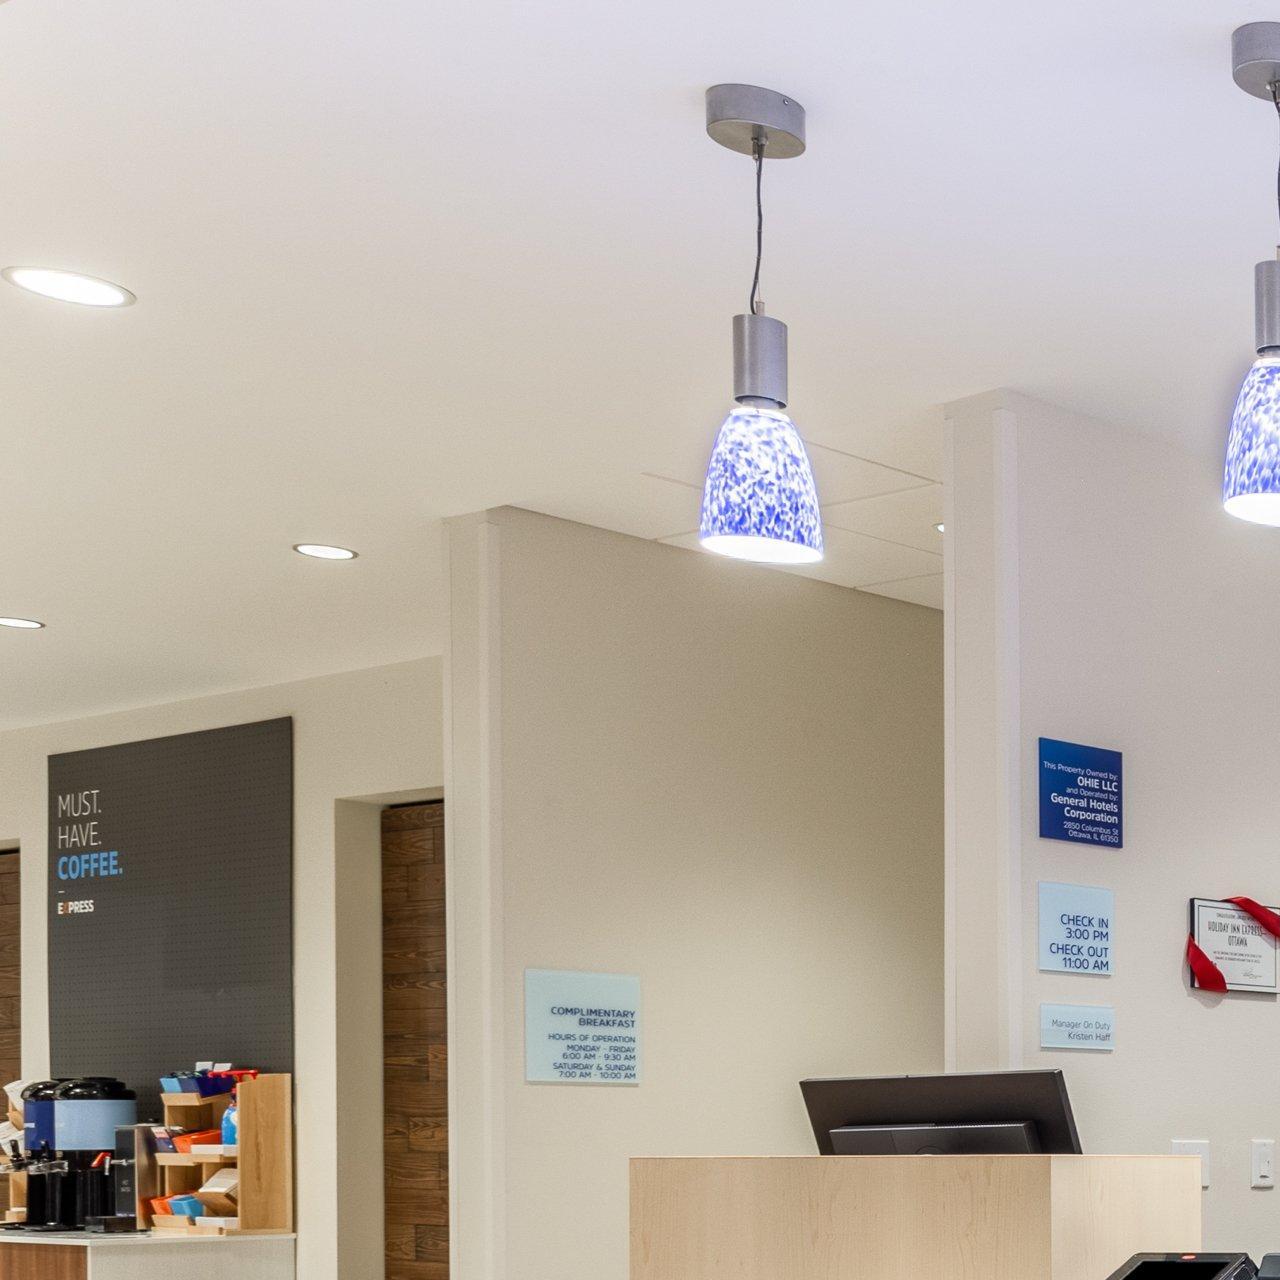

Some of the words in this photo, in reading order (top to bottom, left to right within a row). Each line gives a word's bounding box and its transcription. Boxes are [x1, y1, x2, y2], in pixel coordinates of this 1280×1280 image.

[1043, 761, 1056, 769] This
[1058, 764, 1084, 776] Property
[1086, 769, 1108, 779] Owned
[1077, 776, 1100, 789] OHIE
[1102, 780, 1118, 791] LLC
[1080, 789, 1108, 799] Operated
[58, 789, 102, 818] MUST.
[1050, 793, 1087, 807] General
[1089, 799, 1118, 812] Hotels
[1064, 807, 1118, 824] Corporation
[58, 821, 102, 849] HAVE.
[58, 851, 123, 880] COFFEE.
[1060, 913, 1095, 927] CHECK
[1098, 918, 1109, 928] IN
[1065, 927, 1090, 939] 3:00
[1093, 930, 1109, 941] PM
[1049, 942, 1084, 956] CHECK
[1087, 946, 1109, 958] OUT
[1062, 957, 1090, 969] 11:00
[1092, 959, 1109, 971] AM
[550, 1006, 636, 1019] COMPLIMENTARY
[578, 1017, 636, 1028] BREAKFAST
[1051, 1019, 1081, 1029] Manager
[1083, 1020, 1093, 1029] On
[1095, 1021, 1111, 1031] Duty
[548, 1033, 576, 1041] HOURS
[591, 1034, 636, 1043] OPERATION
[1068, 1031, 1093, 1041] Kristen
[566, 1044, 600, 1052] MONDAY
[609, 1045, 635, 1053] FRIDAY
[562, 1052, 581, 1060] 6:00
[552, 1062, 594, 1070] SATURDAY
[604, 1063, 636, 1072] SUNDAY
[559, 1071, 577, 1079] 7:00
[623, 1072, 636, 1080] AM
